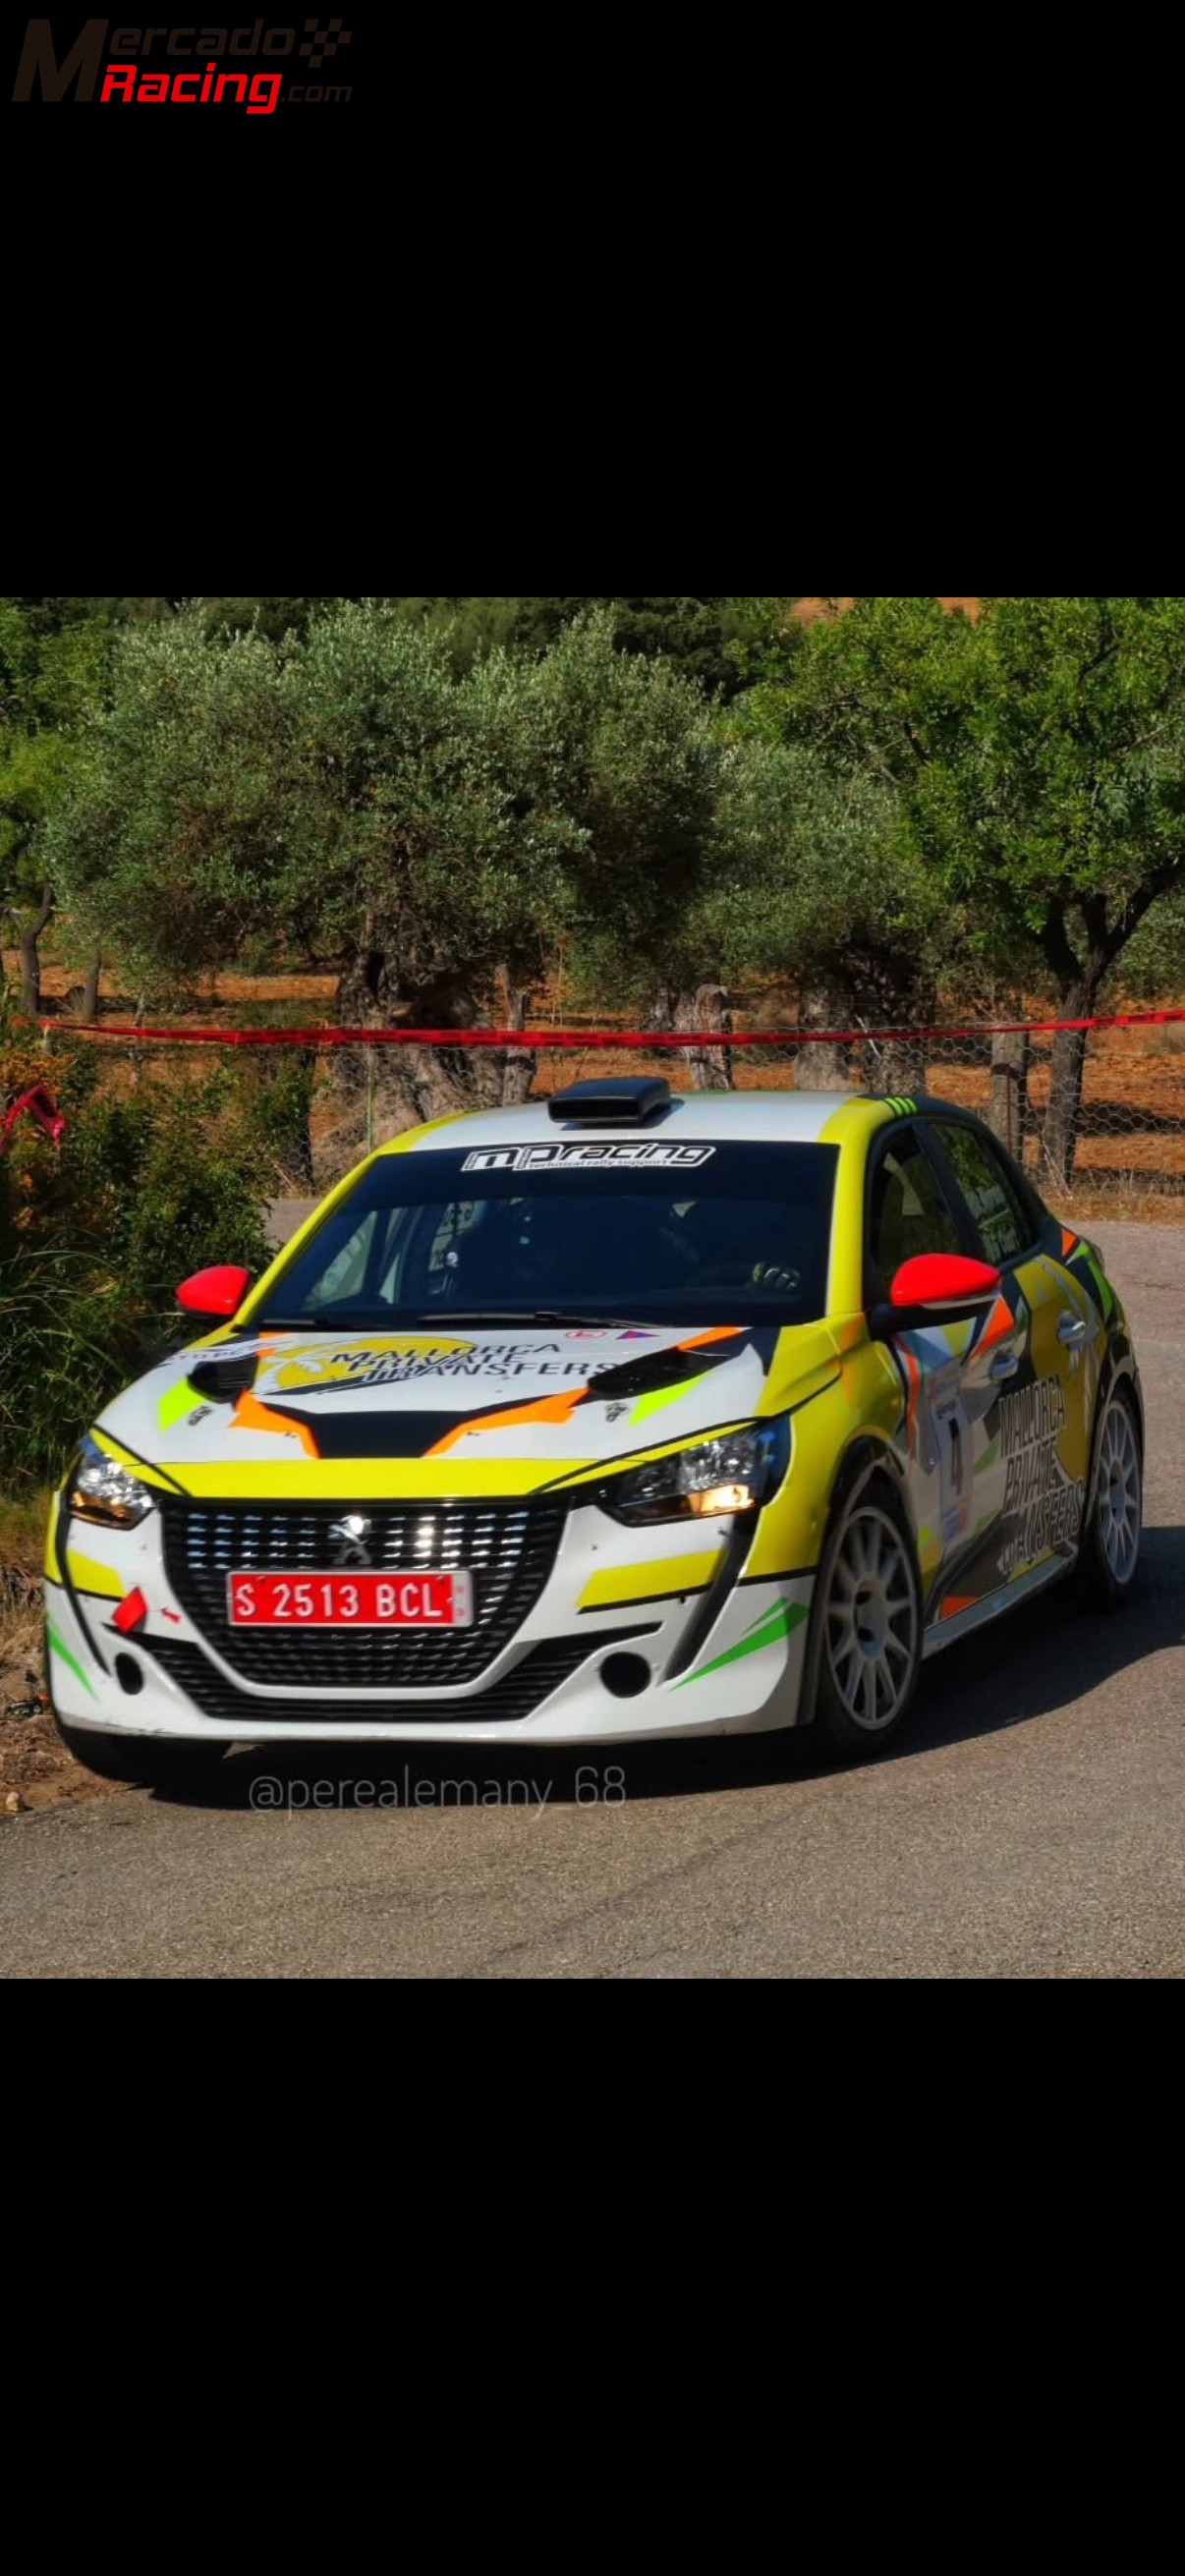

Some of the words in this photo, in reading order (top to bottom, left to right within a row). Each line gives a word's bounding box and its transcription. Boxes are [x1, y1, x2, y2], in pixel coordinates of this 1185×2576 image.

[587, 1158, 615, 1167] rally
[617, 1158, 668, 1167] support
[330, 1343, 561, 1364] MALLORCA
[348, 1352, 527, 1372] PRIVATE
[363, 1362, 618, 1382] TRANSFERS
[998, 1374, 1065, 1459] MALLORCA
[236, 1584, 255, 1617] S
[272, 1583, 359, 1617] 2513
[375, 1583, 442, 1617] BCL
